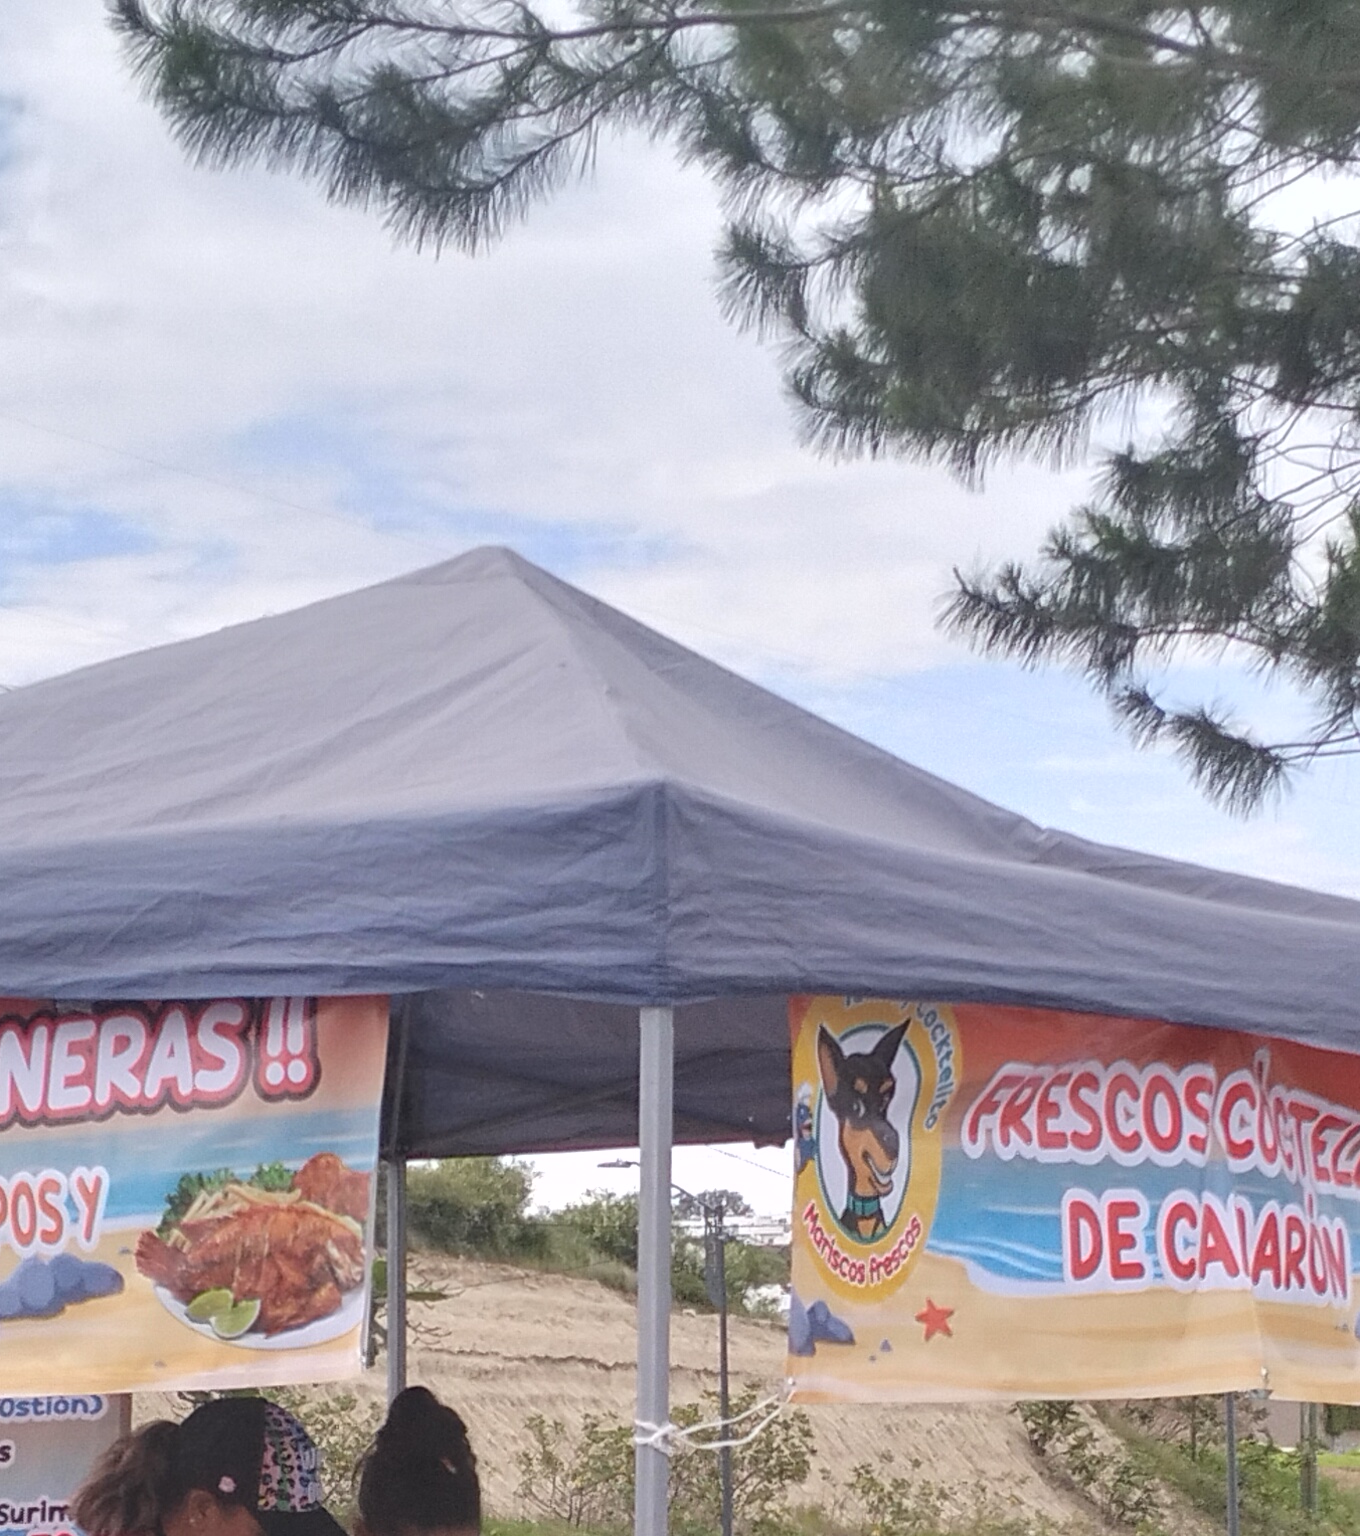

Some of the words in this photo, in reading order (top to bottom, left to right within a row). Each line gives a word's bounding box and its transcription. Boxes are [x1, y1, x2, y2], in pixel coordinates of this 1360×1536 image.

[967, 1070, 1215, 1153] FRESCOS
[73, 1173, 104, 1246] Y
[803, 1202, 866, 1286] Mariscos
[1068, 1198, 1145, 1282] DE
[1163, 1192, 1348, 1300] CAARÓN
